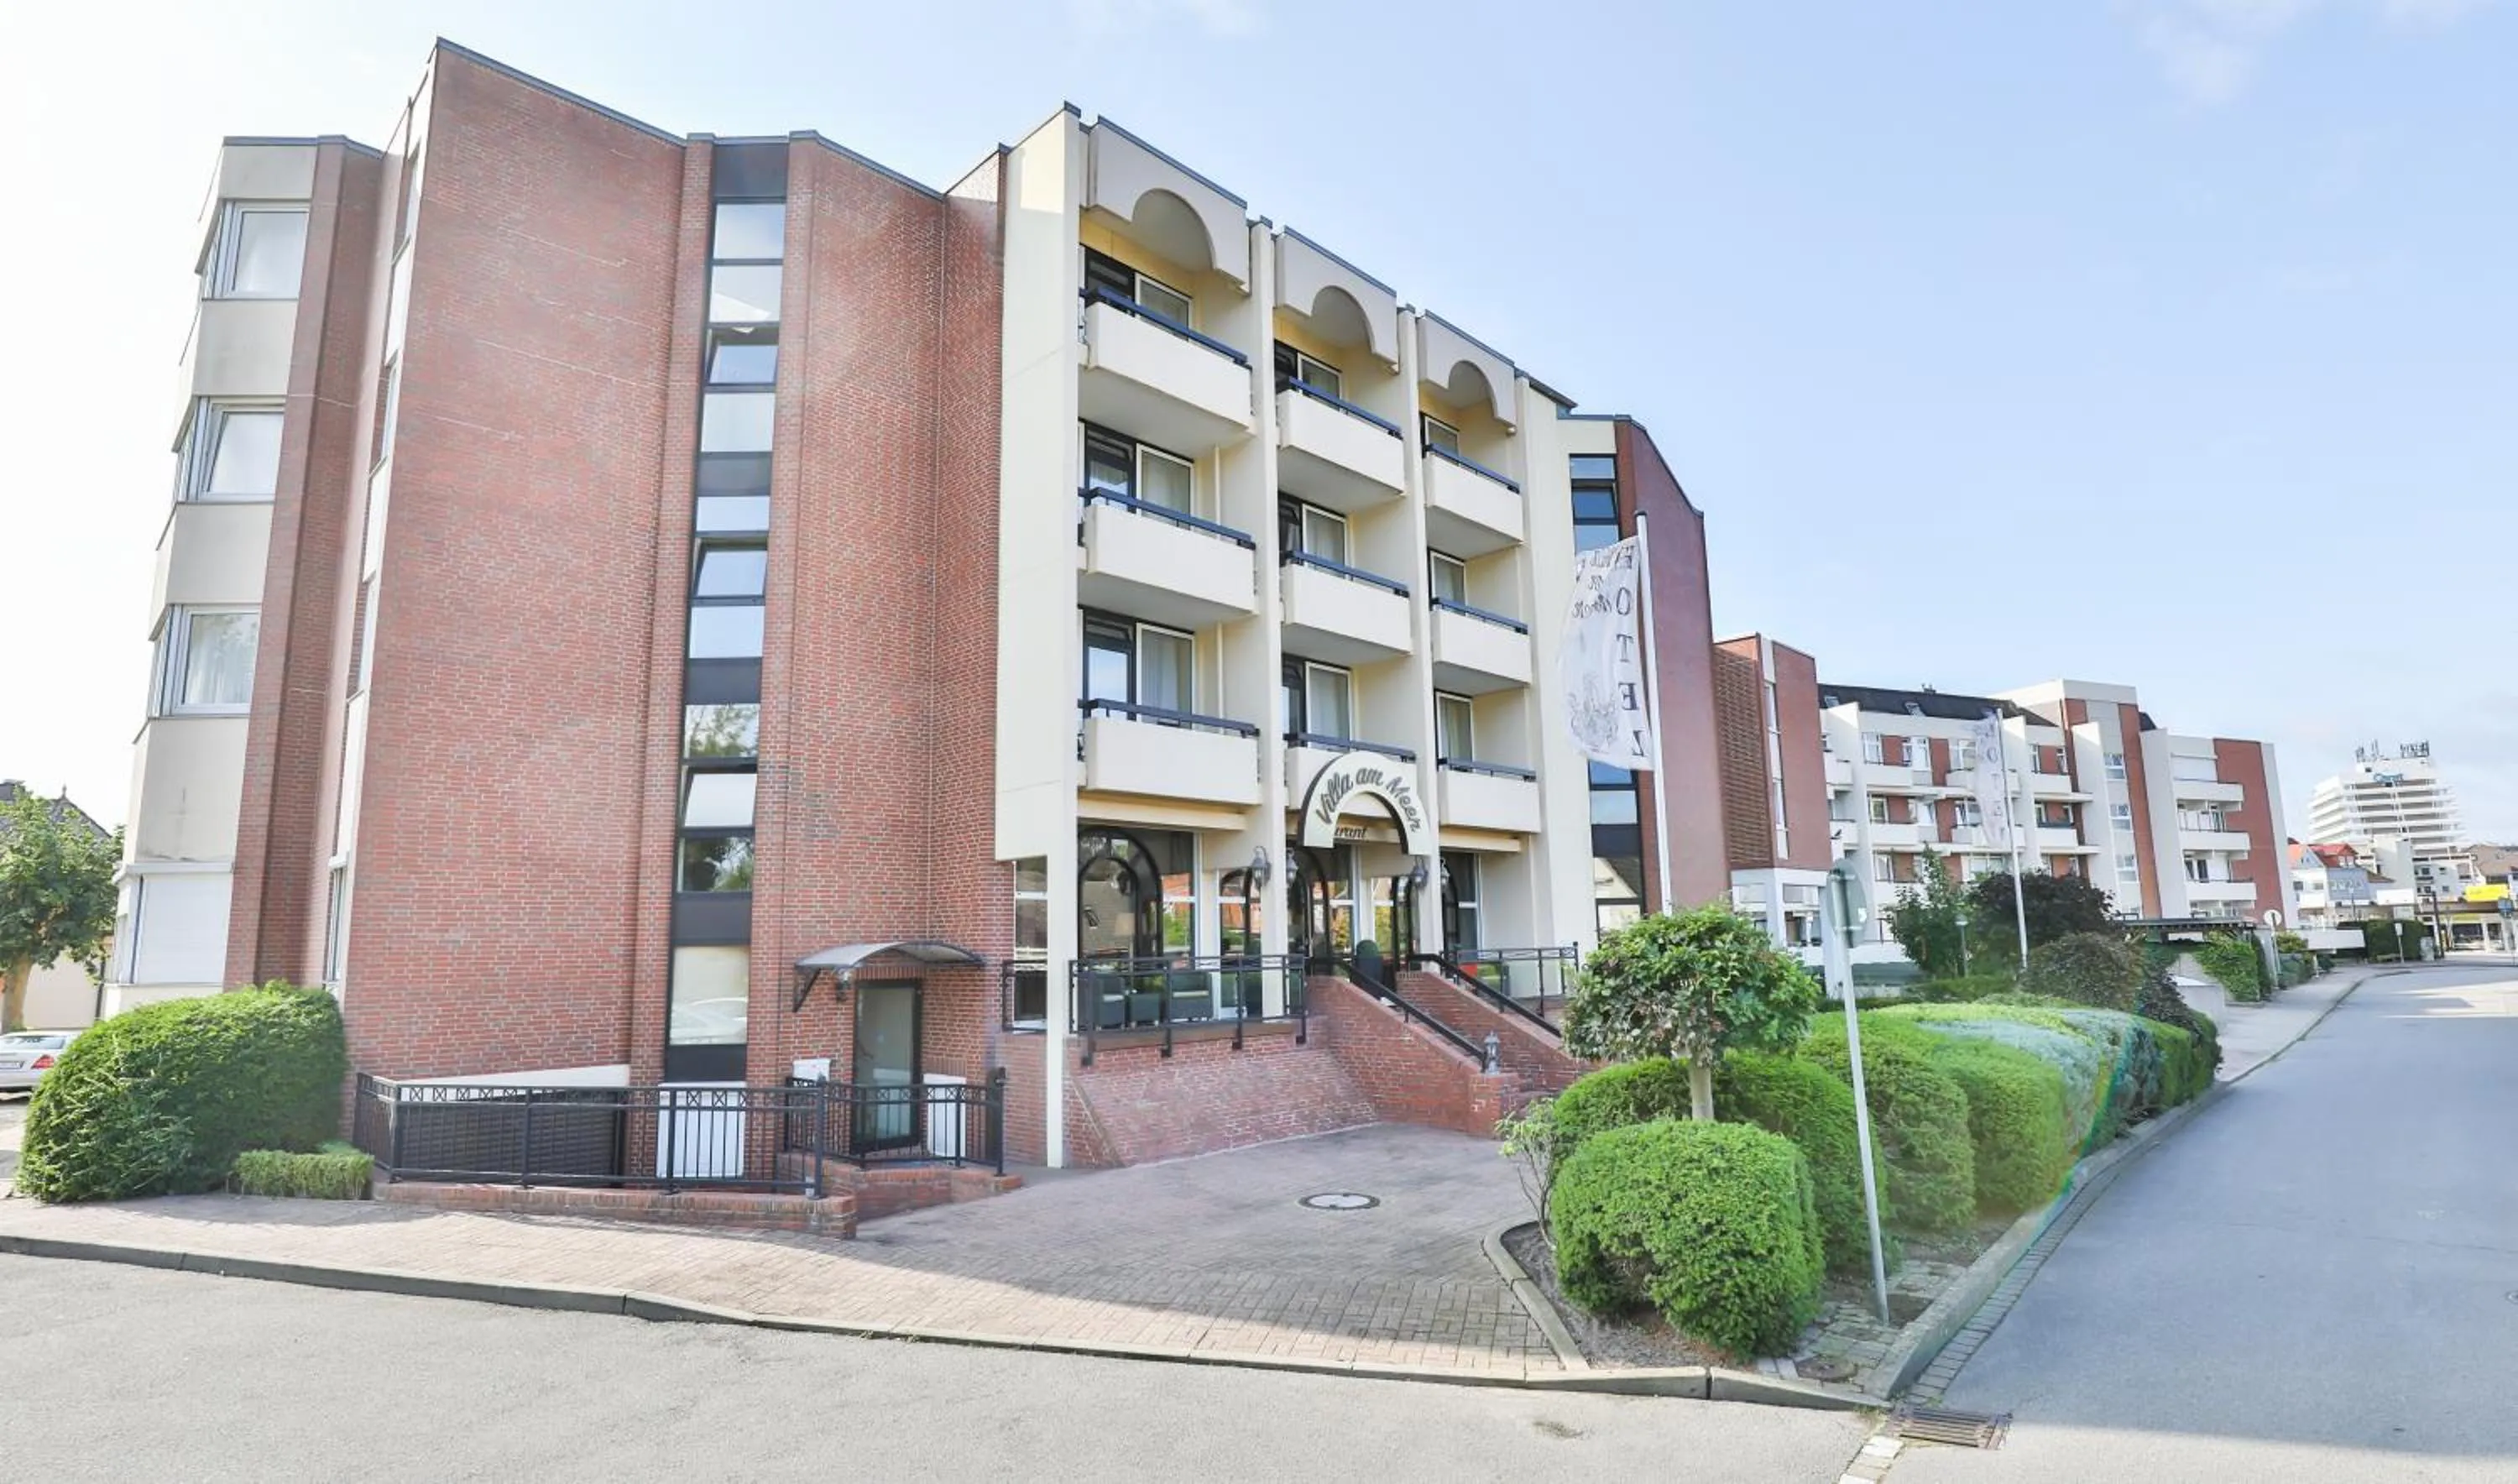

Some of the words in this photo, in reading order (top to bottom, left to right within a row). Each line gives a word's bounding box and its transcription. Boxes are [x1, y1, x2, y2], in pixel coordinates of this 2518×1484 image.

[1315, 771, 1354, 825] Villa
[1356, 766, 1384, 786] am
[1386, 776, 1421, 833] Meer
[1334, 826, 1368, 839] urant
